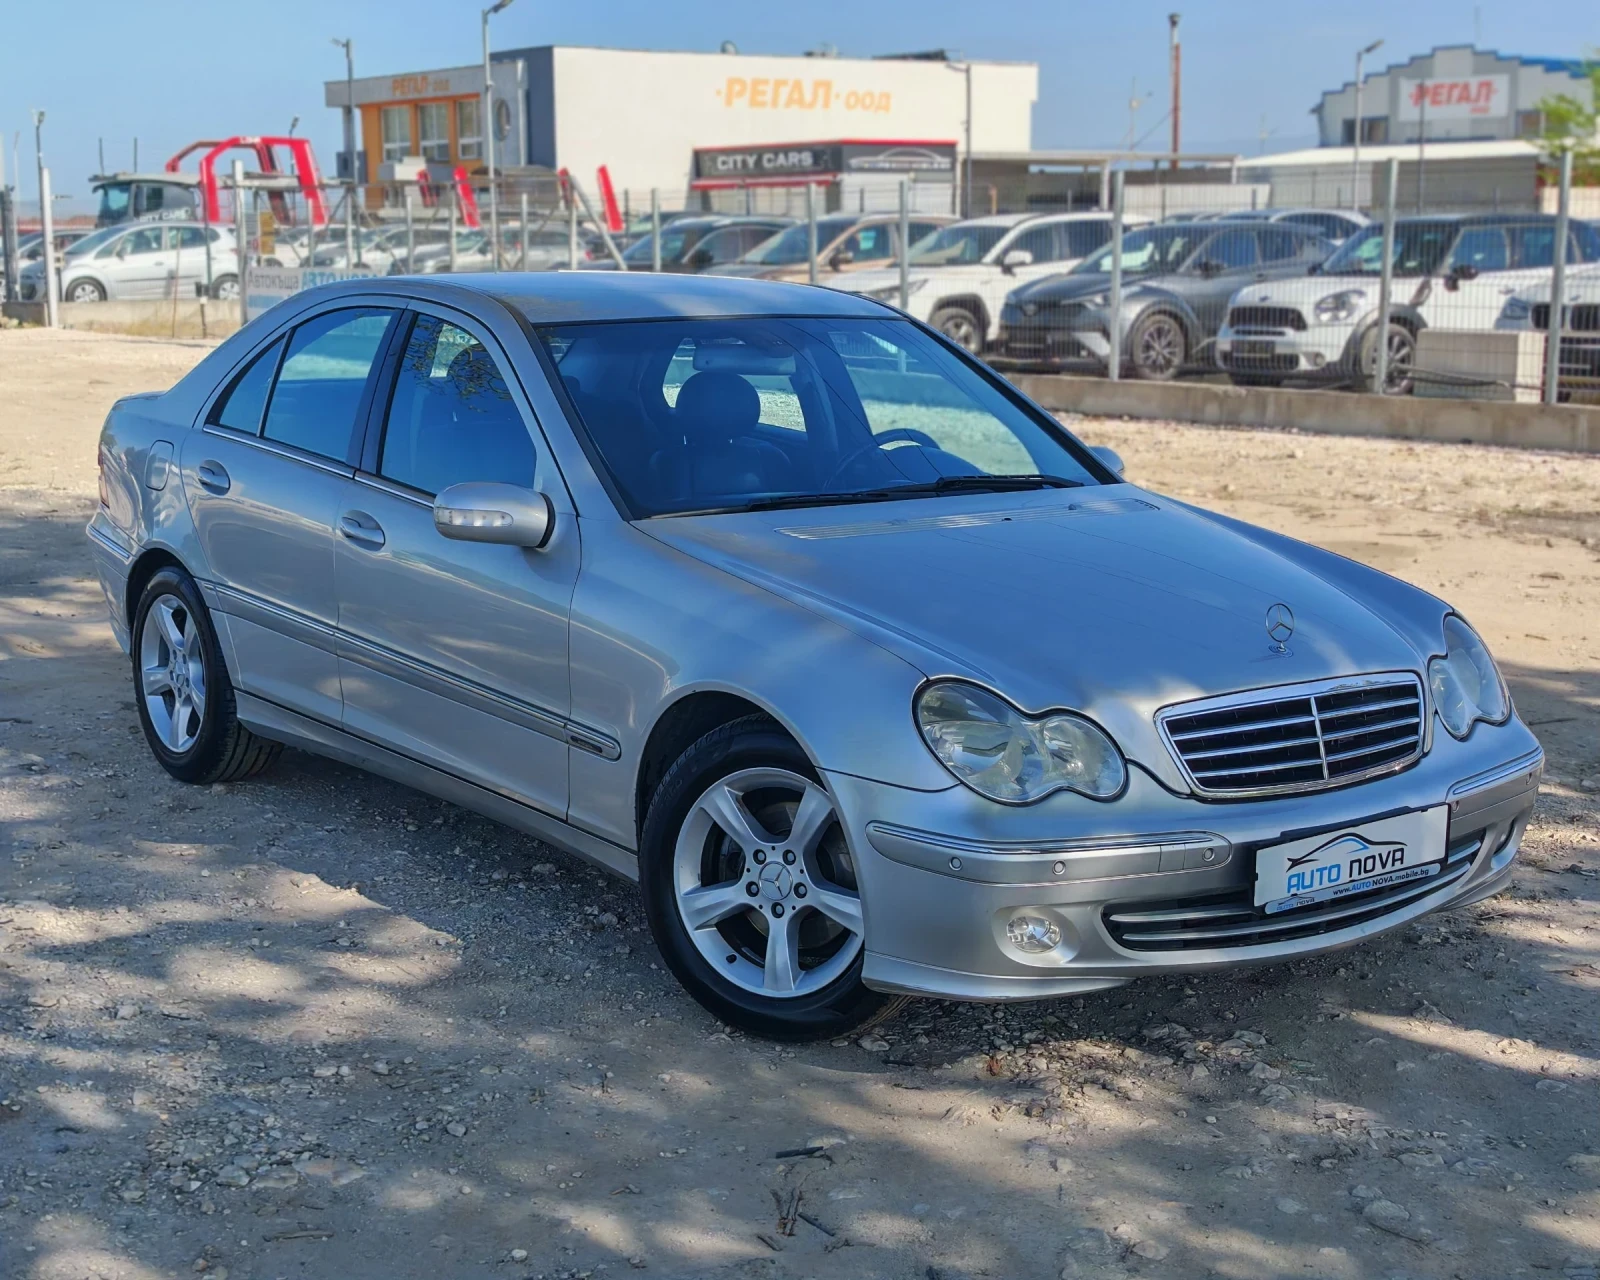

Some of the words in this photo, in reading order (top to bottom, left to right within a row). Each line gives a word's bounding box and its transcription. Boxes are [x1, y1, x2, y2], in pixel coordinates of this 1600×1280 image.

[717, 153, 758, 170] CITY
[763, 150, 813, 168] CARS
[1286, 863, 1341, 894] AUTO
[1348, 847, 1405, 879] NOVA
